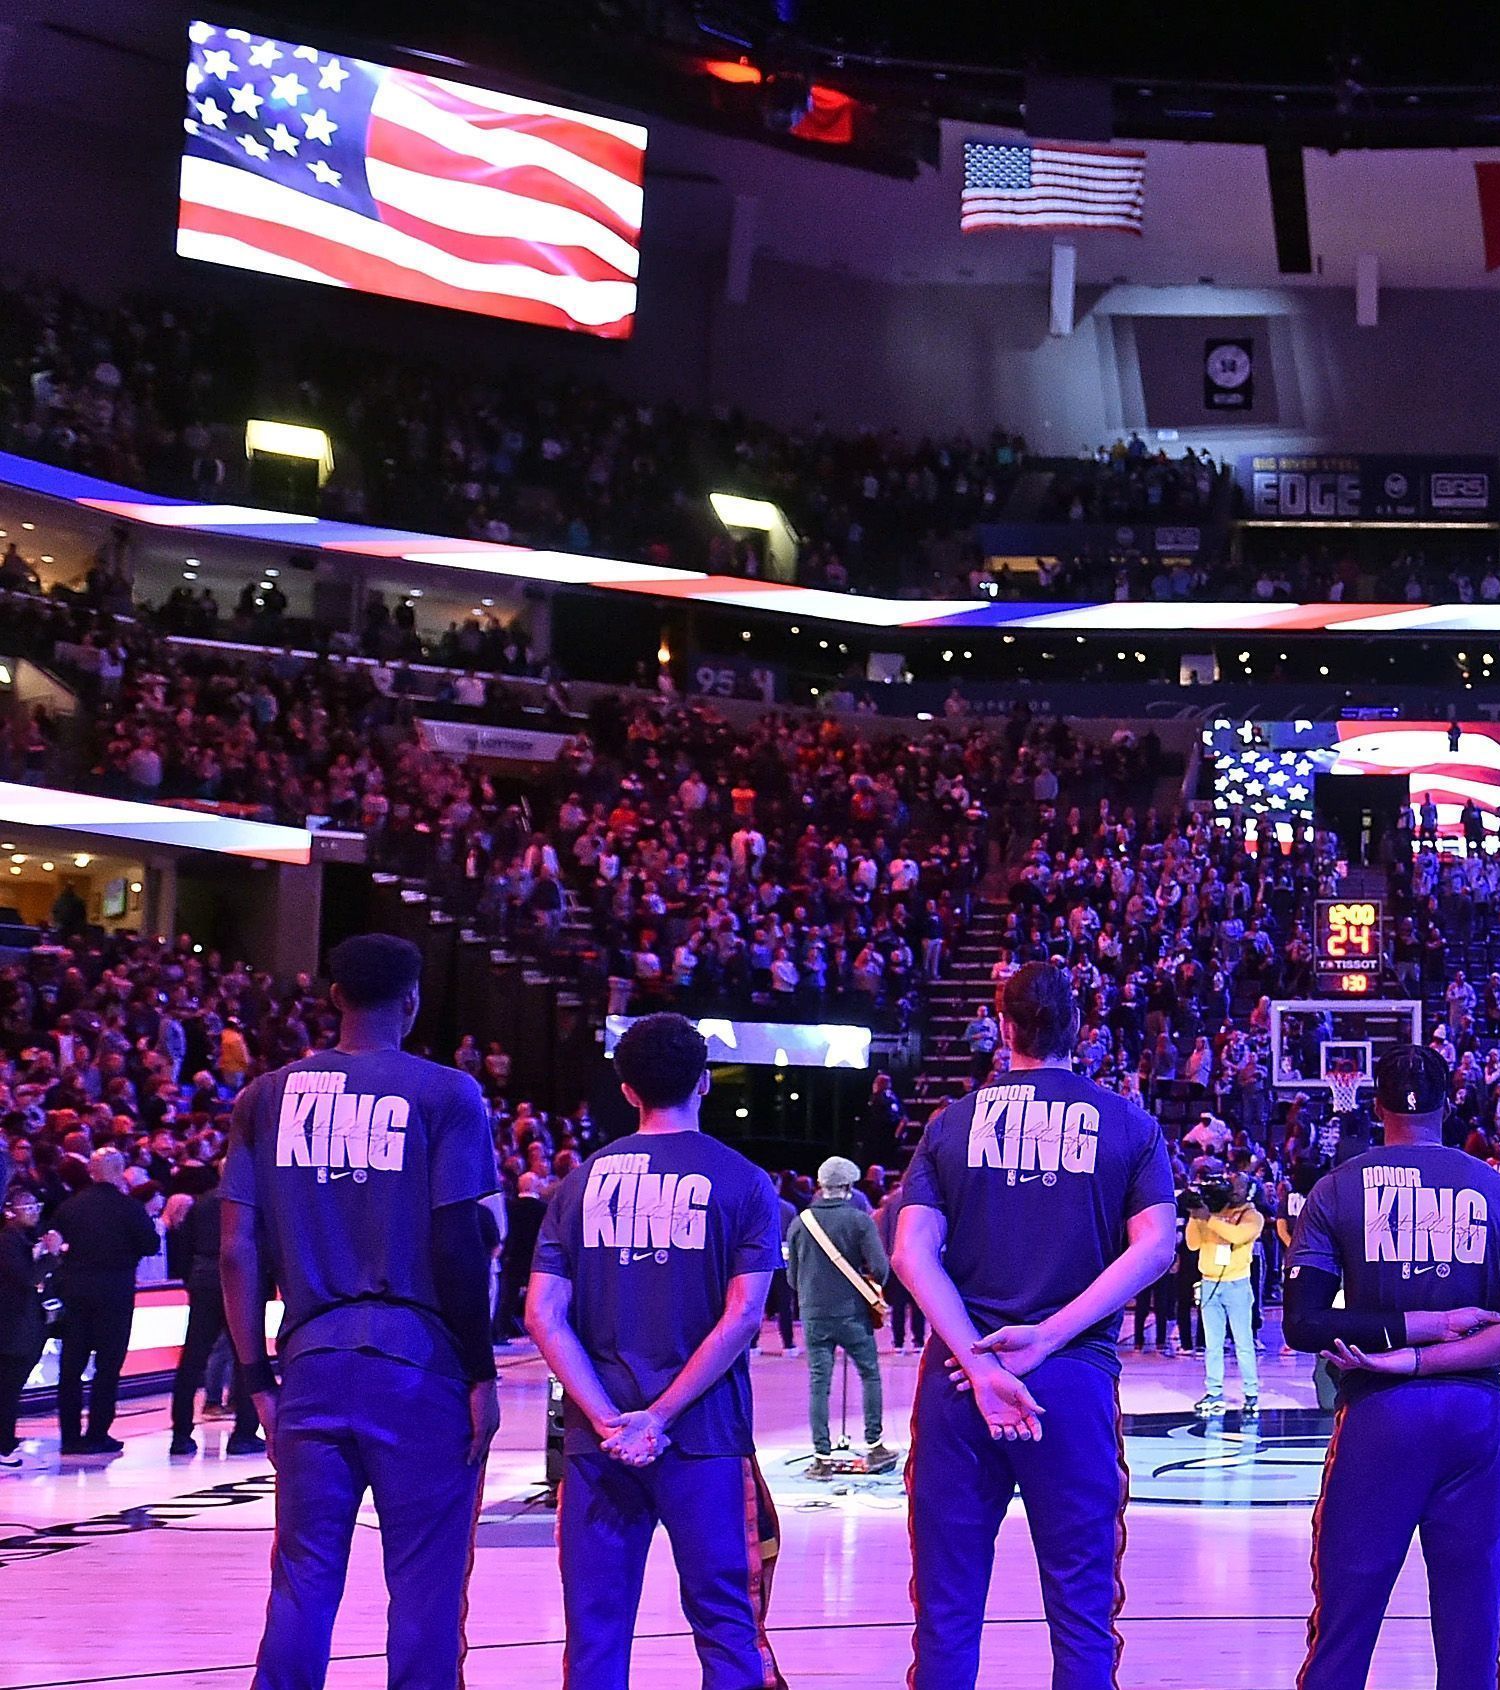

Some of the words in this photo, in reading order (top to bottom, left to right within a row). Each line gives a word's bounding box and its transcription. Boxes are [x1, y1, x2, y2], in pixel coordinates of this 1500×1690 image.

[1253, 472, 1361, 515] EDGE
[1328, 924, 1370, 956] 24
[1334, 959, 1377, 969] TISSOT
[976, 1084, 1036, 1103] HONOR
[276, 1092, 410, 1172] KING
[967, 1099, 1100, 1174] KING
[1362, 1165, 1422, 1188] HONOR
[583, 1173, 712, 1250] KING
[1364, 1186, 1488, 1265] KING
